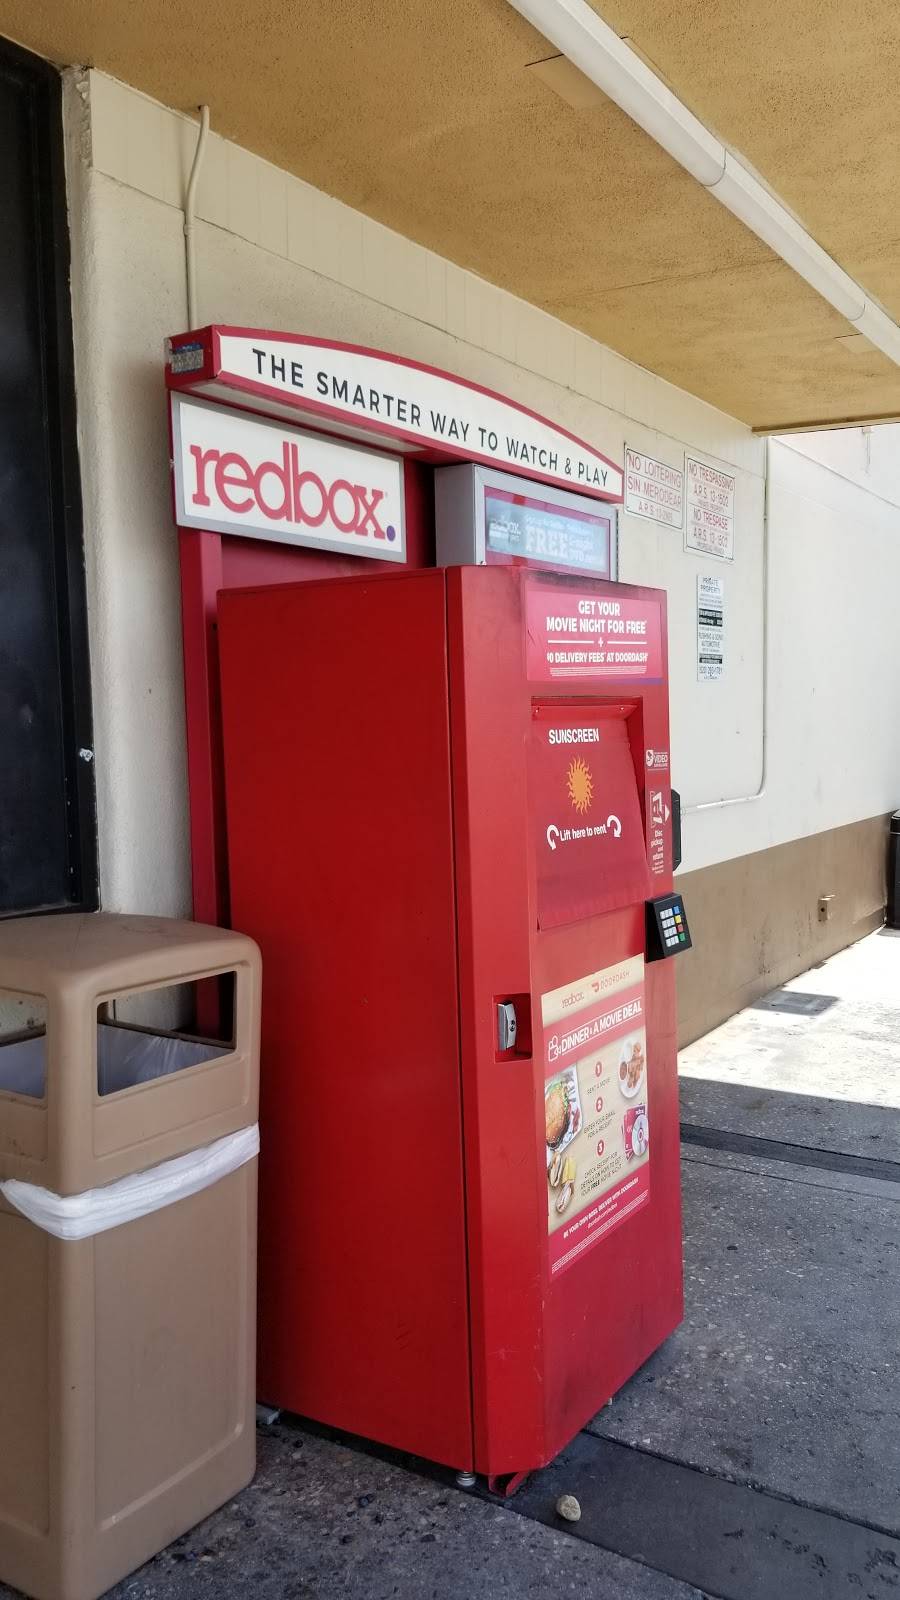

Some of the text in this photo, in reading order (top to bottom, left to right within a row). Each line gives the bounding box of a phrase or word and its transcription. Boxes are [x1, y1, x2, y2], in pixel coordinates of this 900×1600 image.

[252, 348, 608, 487] THE SMARTER WAY TO WATCH & PLAY
[628, 453, 641, 471] NO
[644, 459, 681, 488] LOITERING
[689, 463, 698, 477] NO
[699, 466, 734, 492] TRESPASSING
[628, 475, 641, 492] SIN
[644, 482, 681, 505] MERODEAR
[693, 507, 702, 521] NO
[703, 511, 728, 531] TRESPASE
[525, 526, 569, 560] FREE
[578, 600, 621, 617] GET YOUR
[546, 616, 578, 633] MOVIE
[580, 617, 606, 633] NIGHT
[607, 620, 625, 634] FOR
[555, 651, 588, 664] DELIVERY
[606, 652, 614, 663] AT
[548, 728, 600, 744] SUNSCREEN
[654, 754, 669, 764] VIDEO
[559, 823, 608, 842] Lift here to rent
[600, 970, 630, 990] DOORDASH
[561, 1026, 590, 1053] DINNER
[592, 1021, 600, 1034] A
[599, 1011, 623, 1032] MOVIE
[622, 1001, 643, 1019] DEAL
[590, 1180, 600, 1190] FREE
[569, 1222, 580, 1234] YOUR
